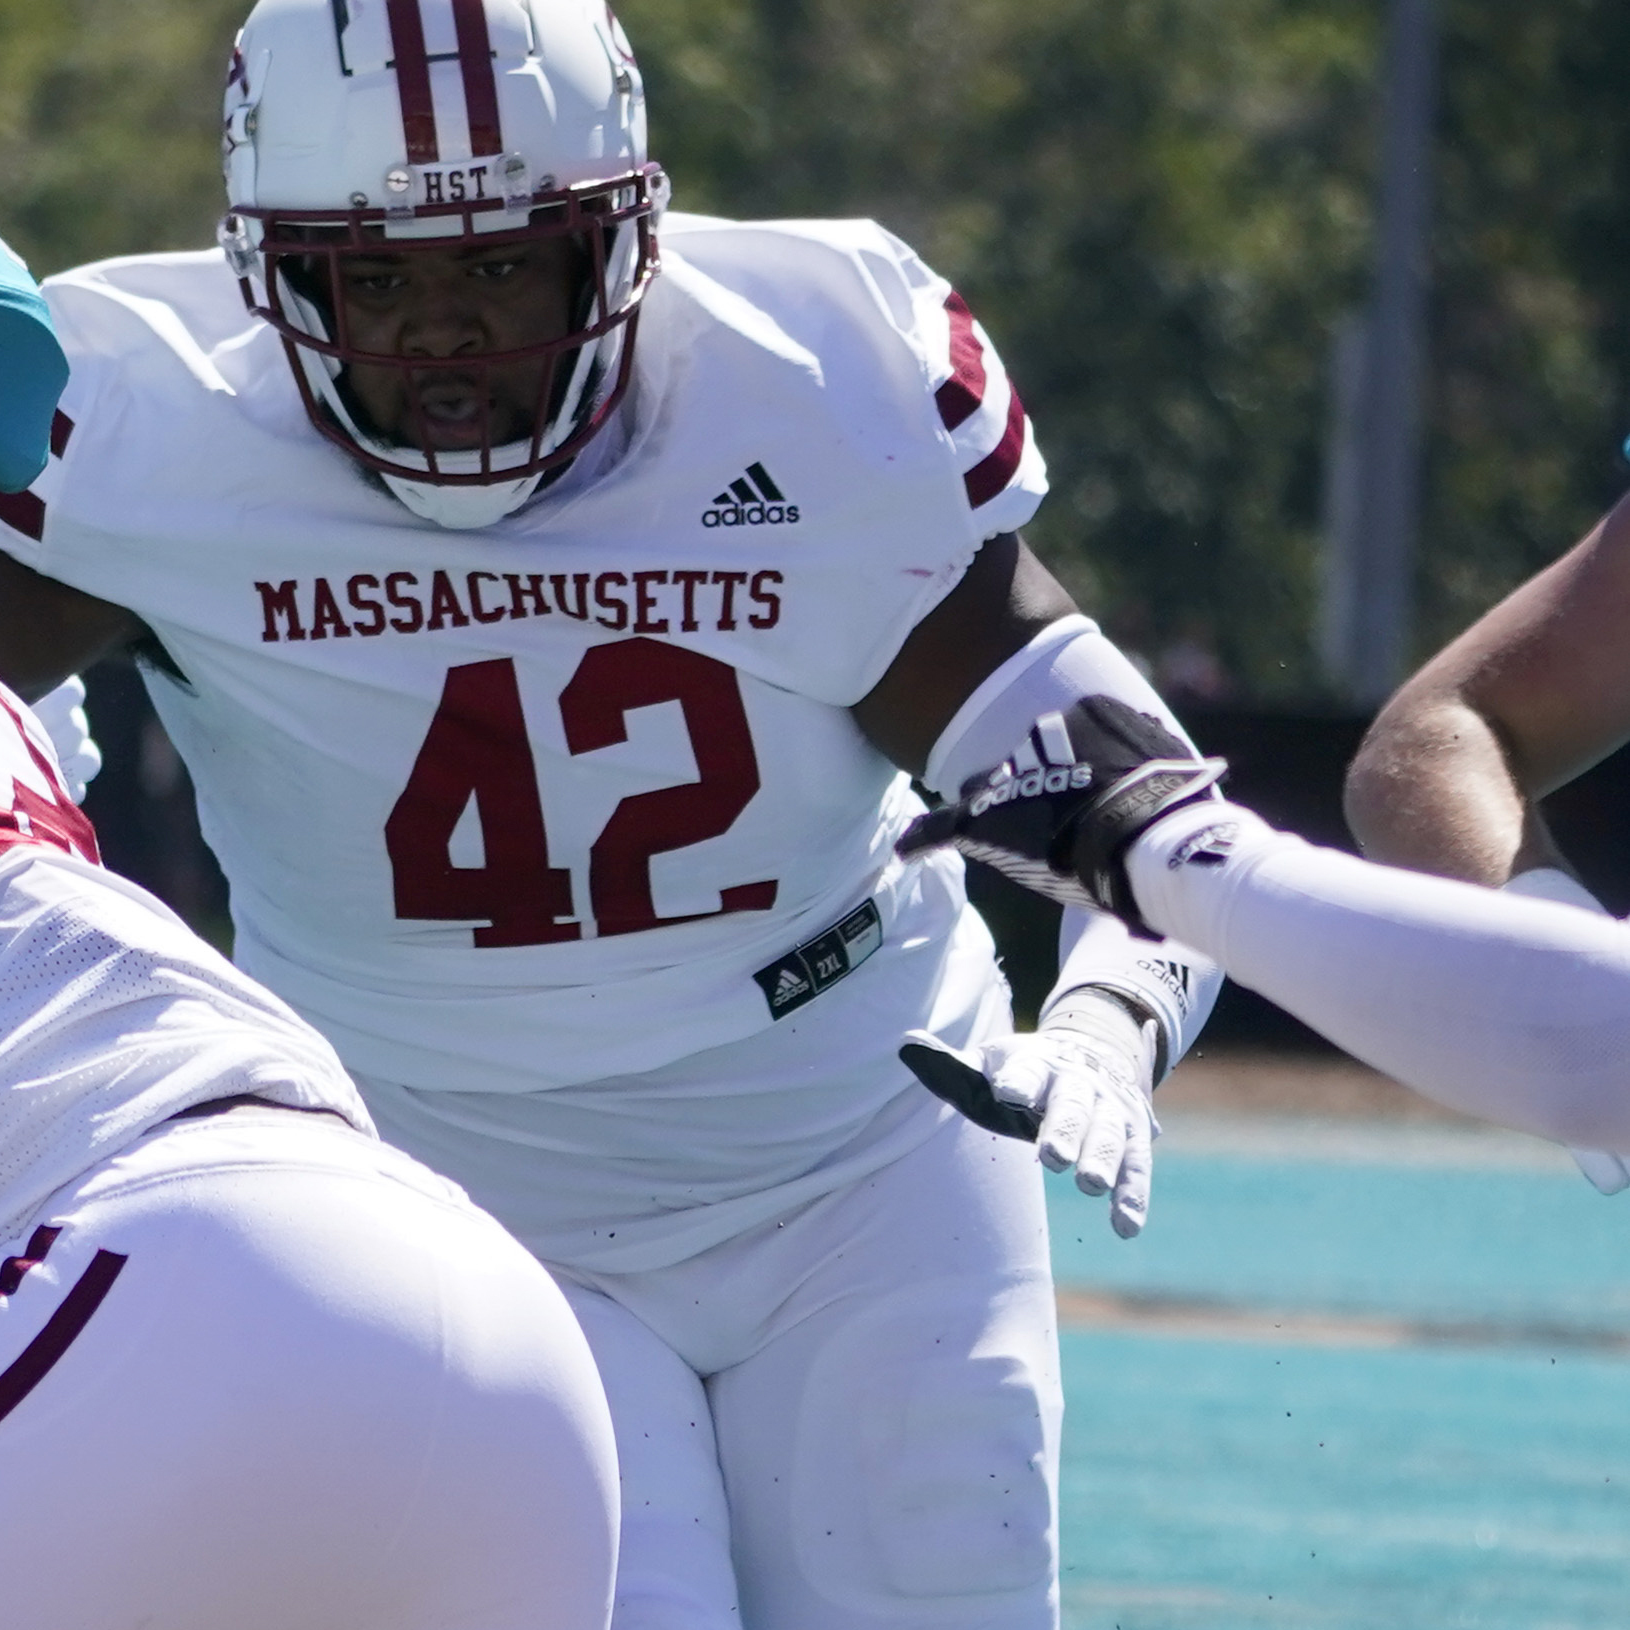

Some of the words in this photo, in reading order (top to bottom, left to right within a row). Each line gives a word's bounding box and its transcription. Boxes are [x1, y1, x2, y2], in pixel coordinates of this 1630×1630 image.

[423, 165, 488, 203] HST
[701, 501, 800, 528] adidas
[253, 569, 785, 642] MASSACHUSETTS
[384, 636, 779, 949] 42
[970, 761, 1093, 817] adidas
[816, 952, 843, 980] 2XL
